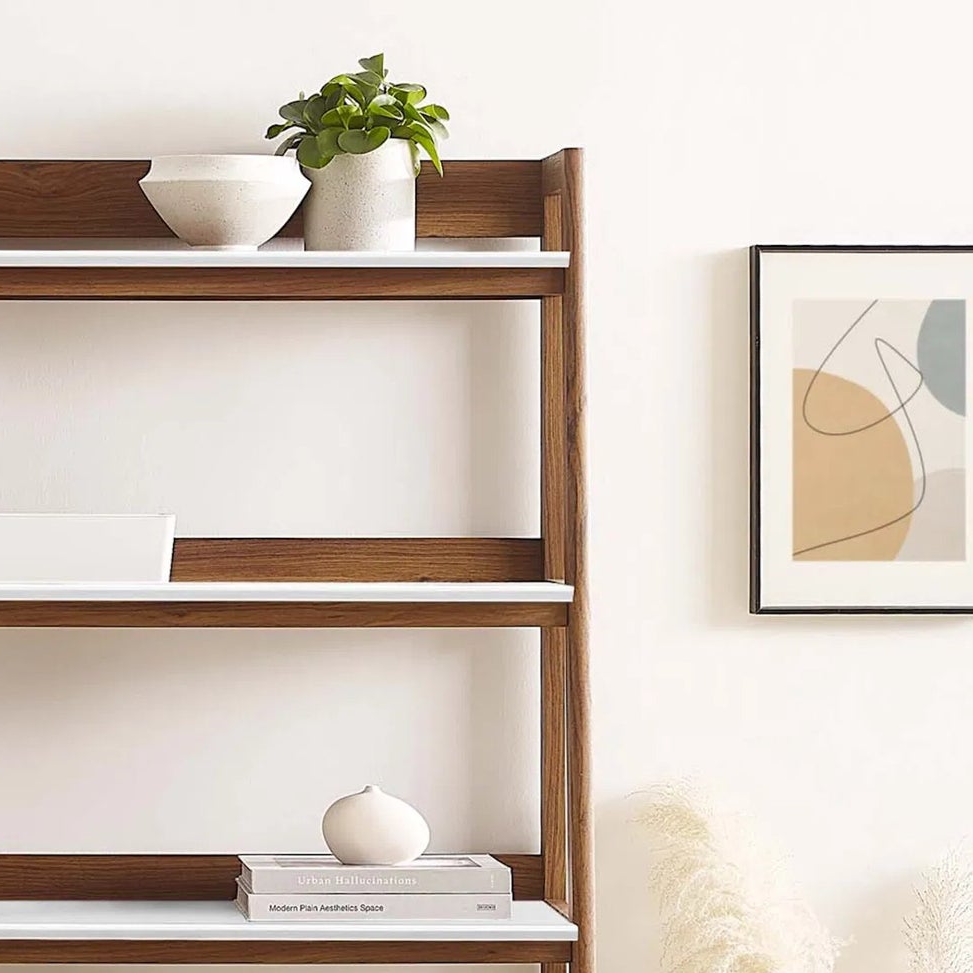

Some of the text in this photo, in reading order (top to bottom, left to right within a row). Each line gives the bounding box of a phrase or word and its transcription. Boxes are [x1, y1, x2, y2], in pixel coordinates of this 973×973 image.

[297, 876, 417, 885] Urban Hallucinations
[269, 904, 384, 913] Modern Plain Aesthetics Space
